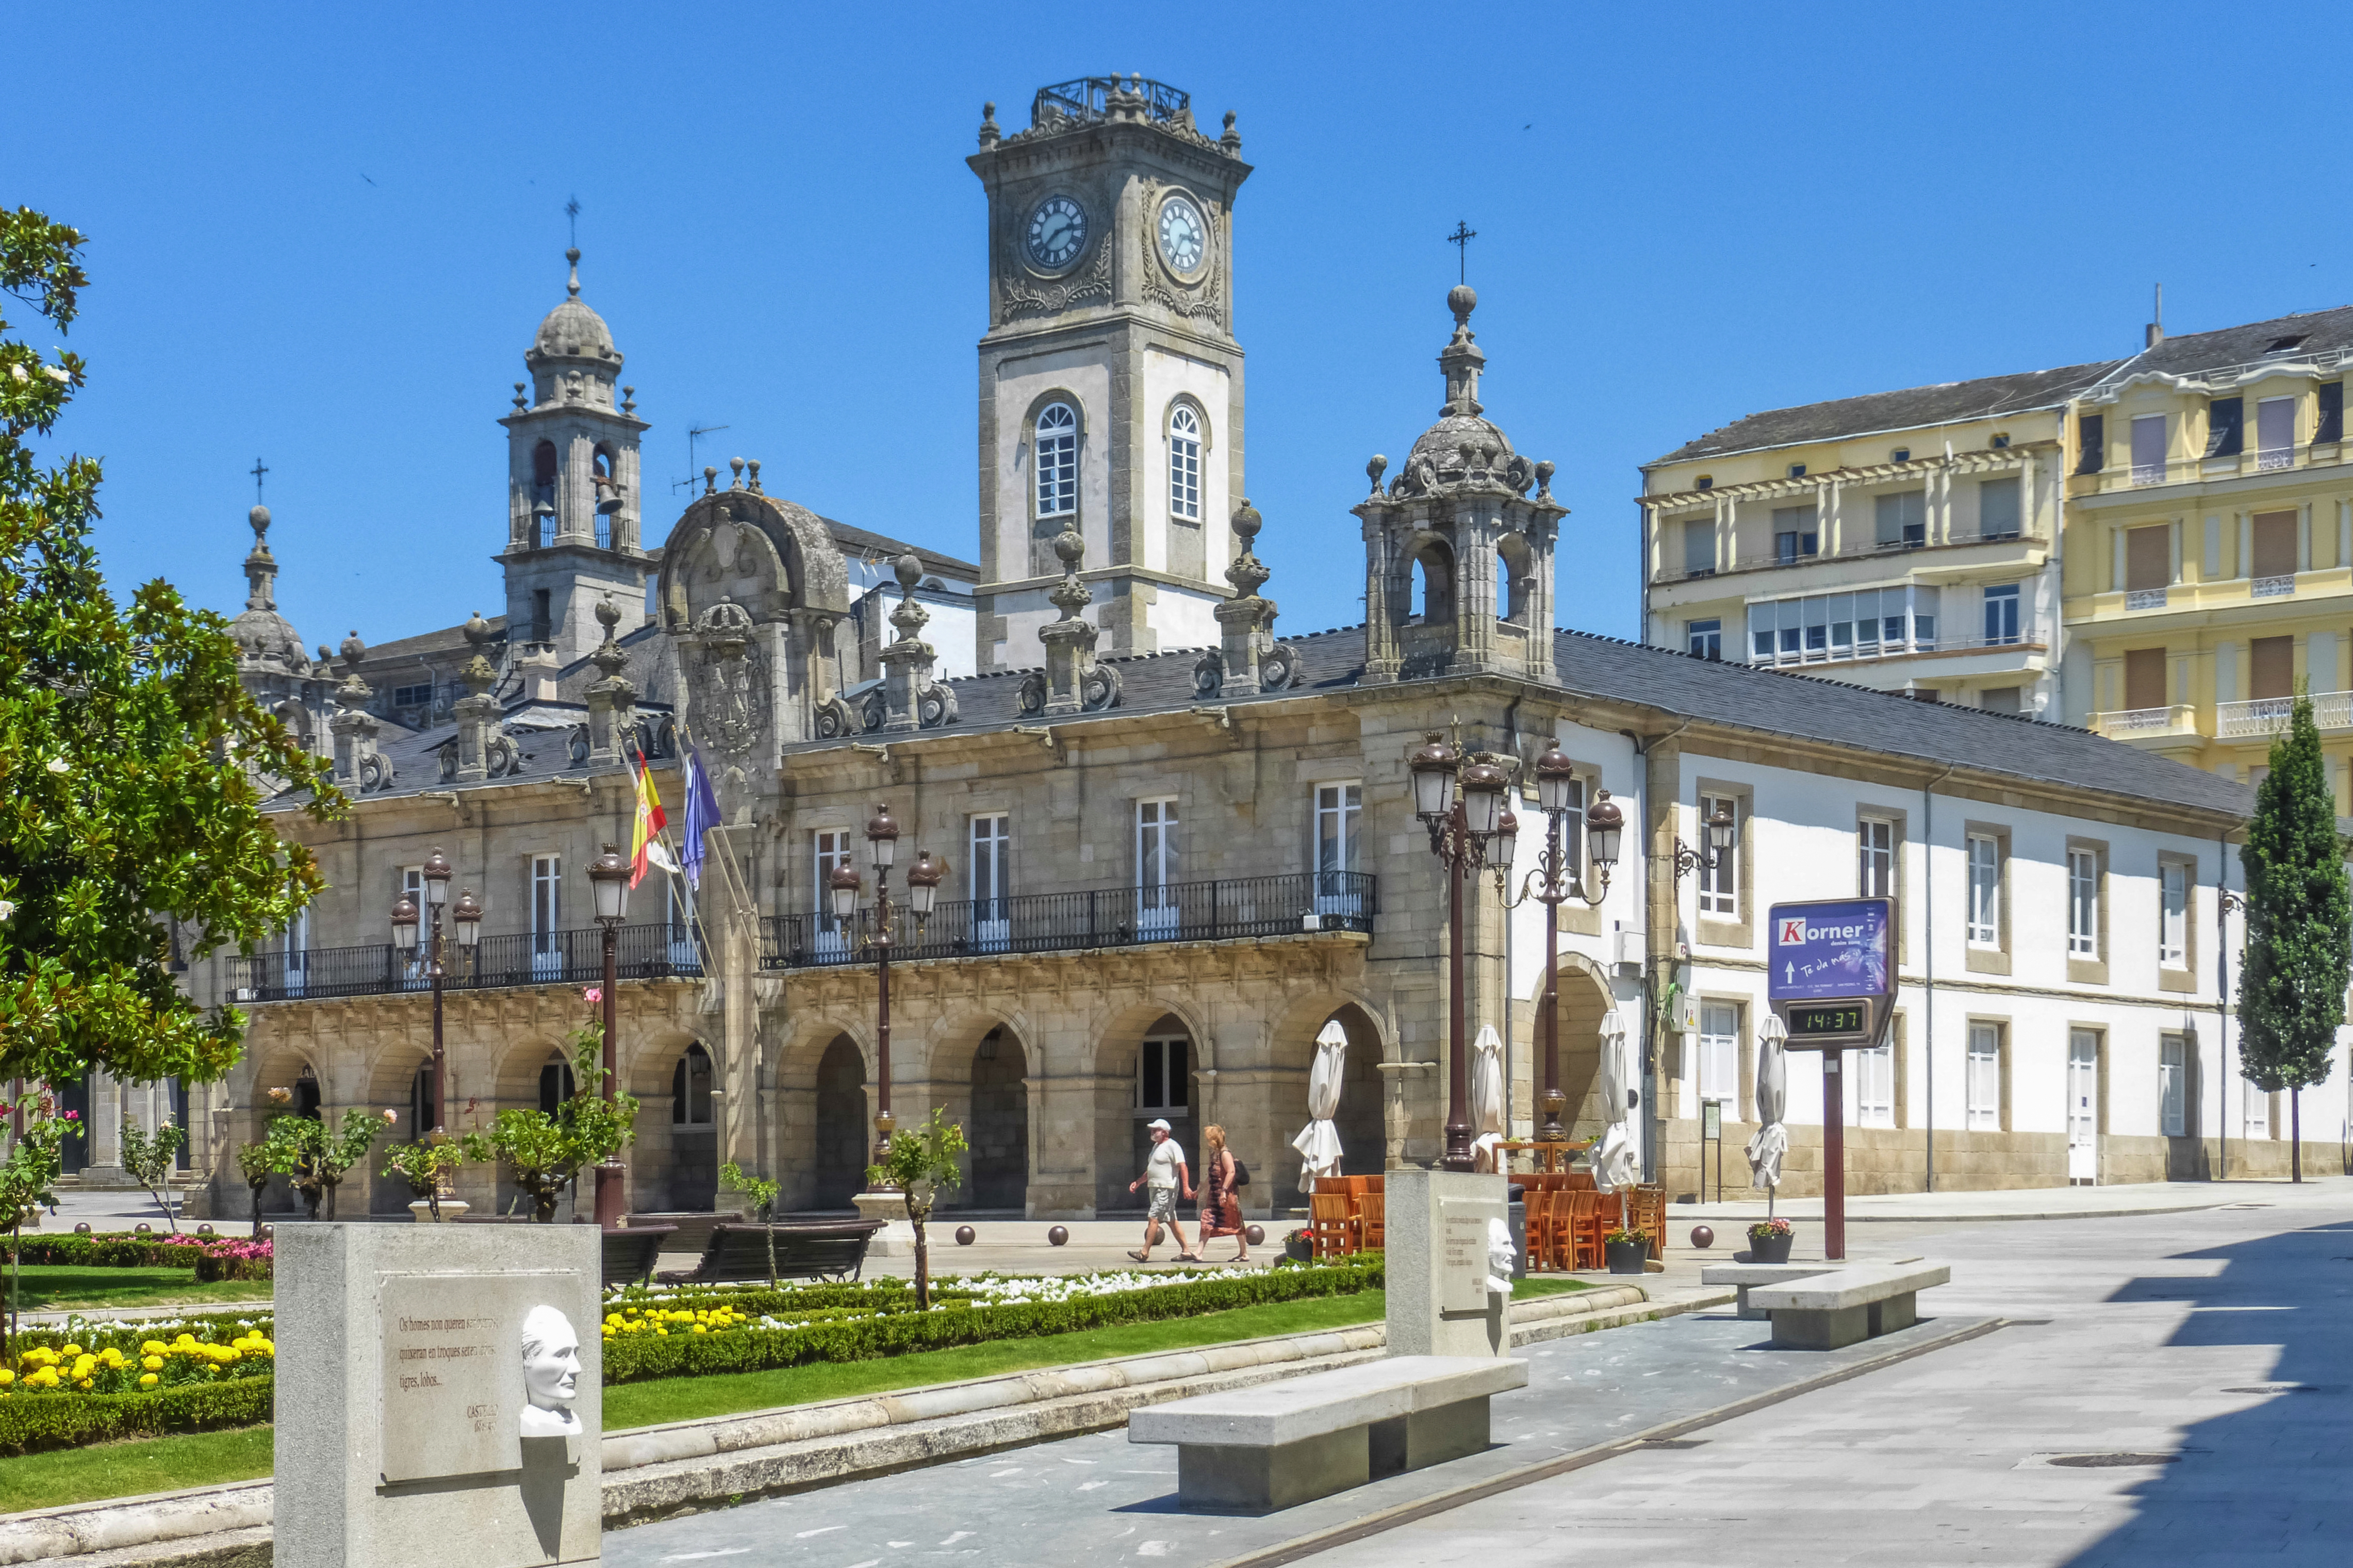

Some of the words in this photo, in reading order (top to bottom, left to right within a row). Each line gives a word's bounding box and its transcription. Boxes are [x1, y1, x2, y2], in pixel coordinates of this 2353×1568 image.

[1781, 921, 1864, 942] Korner
[1800, 964, 1814, 977] Te
[1807, 1012, 1856, 1028] 14:37
[400, 1317, 408, 1331] Os
[409, 1316, 430, 1331] homes
[431, 1319, 443, 1330] non
[445, 1319, 465, 1333] queren
[400, 1345, 426, 1363] quixeran
[429, 1348, 436, 1358] en
[437, 1345, 460, 1362] troques
[400, 1374, 419, 1392] tigres,
[420, 1372, 442, 1387] lobos...
